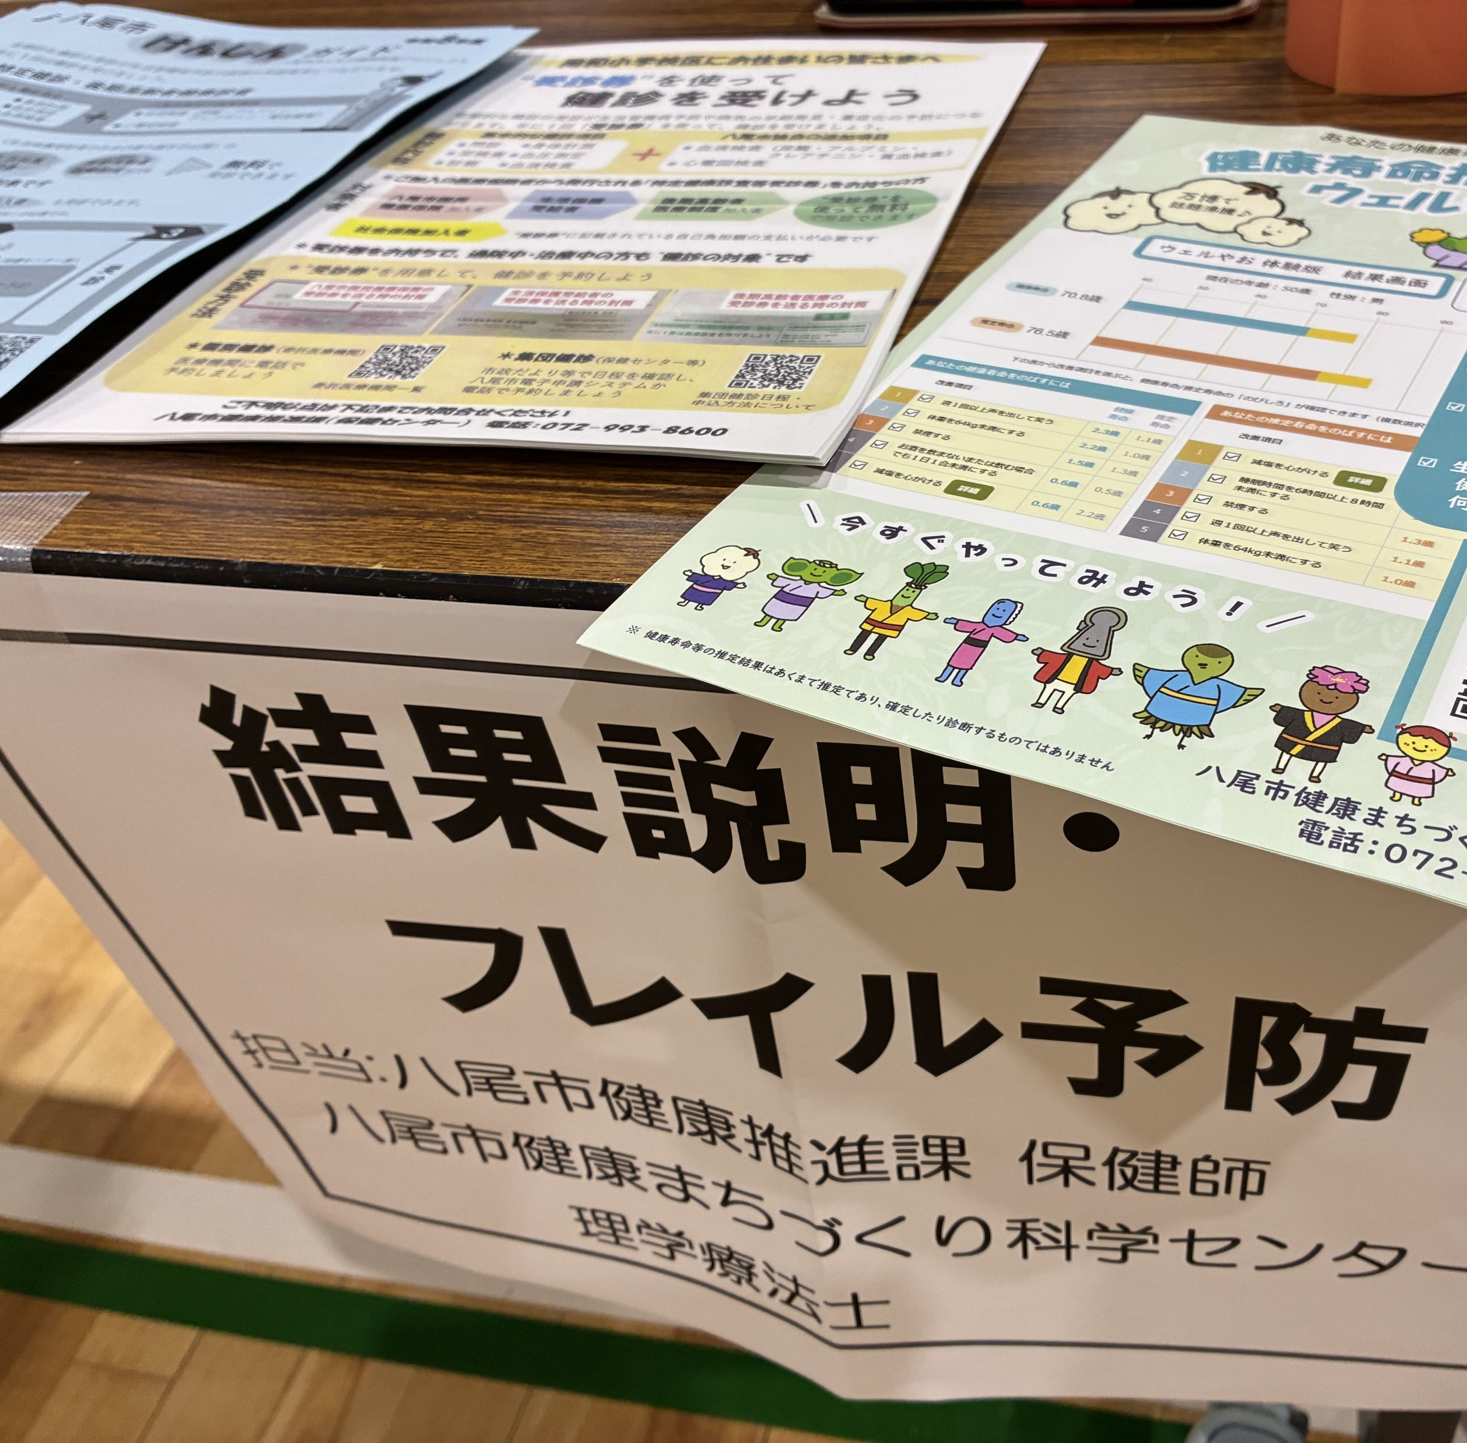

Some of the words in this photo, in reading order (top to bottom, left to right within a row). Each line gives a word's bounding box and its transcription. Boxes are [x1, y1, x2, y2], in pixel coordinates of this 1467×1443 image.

[559, 88, 921, 108] 健診を受けよう
[353, 225, 472, 238] 社会保険加入者
[1159, 244, 1253, 266] ウェルやお
[1260, 258, 1324, 276] 体験版
[1343, 269, 1430, 289] 結果画面
[732, 291, 845, 302] 後期高齢者医療の
[1060, 290, 1103, 303] 70.8歳
[1026, 326, 1071, 340] 76.5歳
[163, 366, 274, 380] 予約しましょう
[174, 356, 306, 371] 医療機関に電話で
[469, 376, 668, 391] 八尾市電子申請システムか
[481, 366, 696, 383] 市政だより等で日程を確認し、
[924, 358, 1072, 390] あなたの健康寿命をのばすには
[461, 385, 624, 399] 電話で予約しましょう
[934, 378, 975, 392] 改善項目
[690, 399, 818, 412] 申込方法について
[1091, 426, 1121, 439] 2.3歳
[1135, 435, 1163, 446] 1.1歳
[1218, 409, 1395, 444] あなたの推定寿命をのばすには
[1237, 432, 1284, 447] 改善項目
[1078, 441, 1109, 454] 2.2歳
[1122, 450, 1152, 462] 1.0歳
[897, 442, 1037, 476] お酒を飲まないまたは飲む場合
[1050, 477, 1080, 490] 0.6歳
[1094, 485, 1125, 498] 0.5歳
[1067, 457, 1096, 470] 1.5歳
[1110, 466, 1140, 478] 1.3歳
[1180, 470, 1189, 478] 2
[1250, 456, 1330, 479] 減塩を心がける
[872, 466, 943, 488] 減塩を心がける
[1030, 499, 1062, 512] 0.6歳
[1075, 508, 1107, 522] 2.2歳
[1165, 489, 1174, 498] 3
[1222, 500, 1269, 516] 禁煙する
[1232, 484, 1290, 501] 未満にする
[1152, 507, 1162, 516] 4
[1400, 535, 1435, 549] 1.3歳
[1139, 525, 1149, 534] 5
[1198, 537, 1323, 569] 体重を64kg未満にする
[1390, 555, 1426, 569] 1.1歳
[1381, 575, 1417, 589] 1.0歳
[643, 627, 1117, 774] 健康寿命等の推定結果はあくまで推定であり、確定したり診断するものではありません
[384, 918, 1430, 1122] フレイル予防
[1016, 1135, 1272, 1203] 保健師
[567, 1202, 892, 1333] 理学療法士
